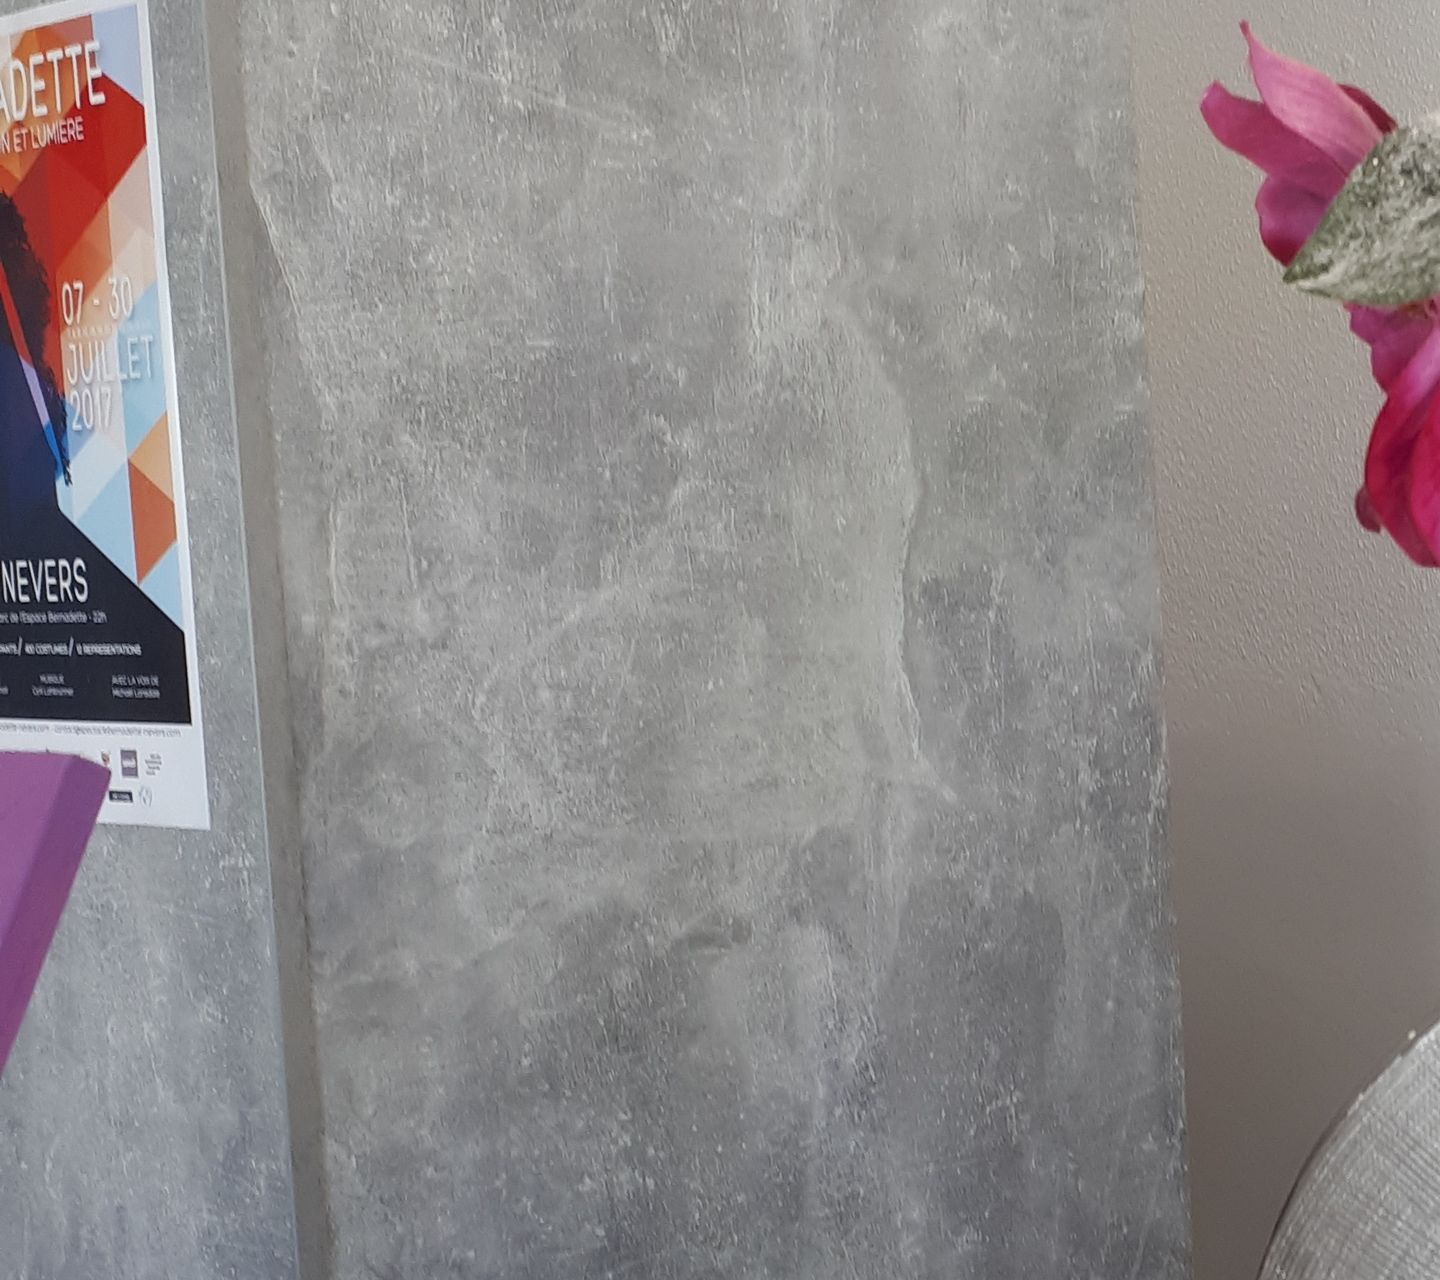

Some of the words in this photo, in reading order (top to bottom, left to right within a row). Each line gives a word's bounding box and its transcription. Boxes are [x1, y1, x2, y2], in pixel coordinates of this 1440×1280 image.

[13, 128, 29, 153] ET
[62, 280, 84, 326] 07
[108, 276, 133, 320] 30
[67, 335, 153, 384] JUILLET
[70, 385, 112, 431] 2017
[0, 557, 88, 603] NEVERS
